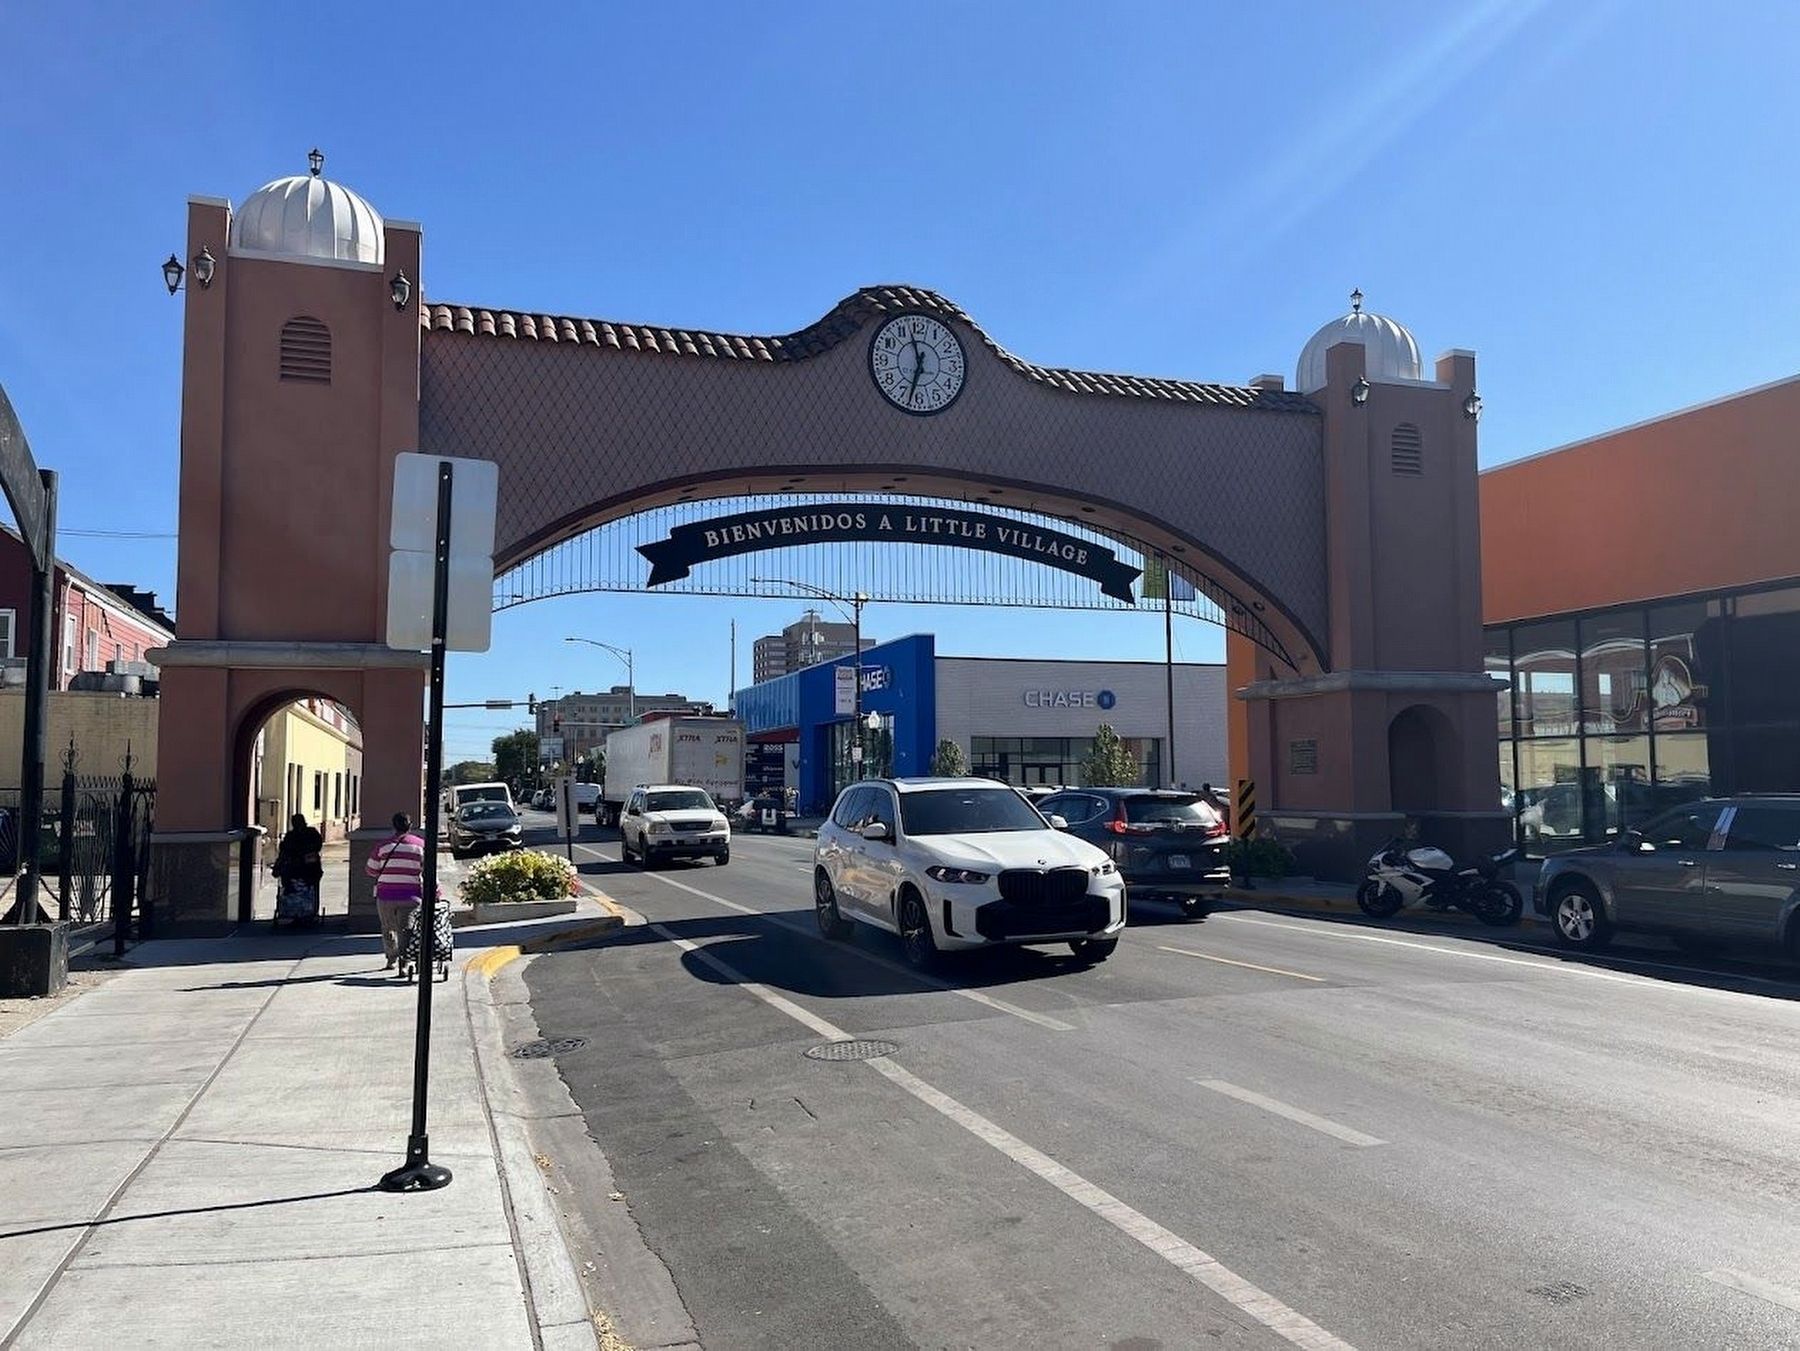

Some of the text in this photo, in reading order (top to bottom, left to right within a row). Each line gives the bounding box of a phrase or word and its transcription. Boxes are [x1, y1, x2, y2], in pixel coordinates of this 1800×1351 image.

[898, 326, 906, 337] 11
[913, 322, 925, 334] 12
[933, 329, 937, 339] 1
[885, 338, 896, 349] 10
[943, 342, 951, 353] 2
[879, 354, 888, 366] 9
[949, 360, 957, 372] 3
[885, 372, 894, 385] 8
[944, 378, 951, 389] 4
[899, 386, 907, 398] 7
[915, 392, 923, 404] 6
[932, 389, 940, 401] 5
[704, 513, 1088, 565] BIENVENIDOS A LITTLE VILLAGE
[1025, 691, 1094, 707] CHASE
